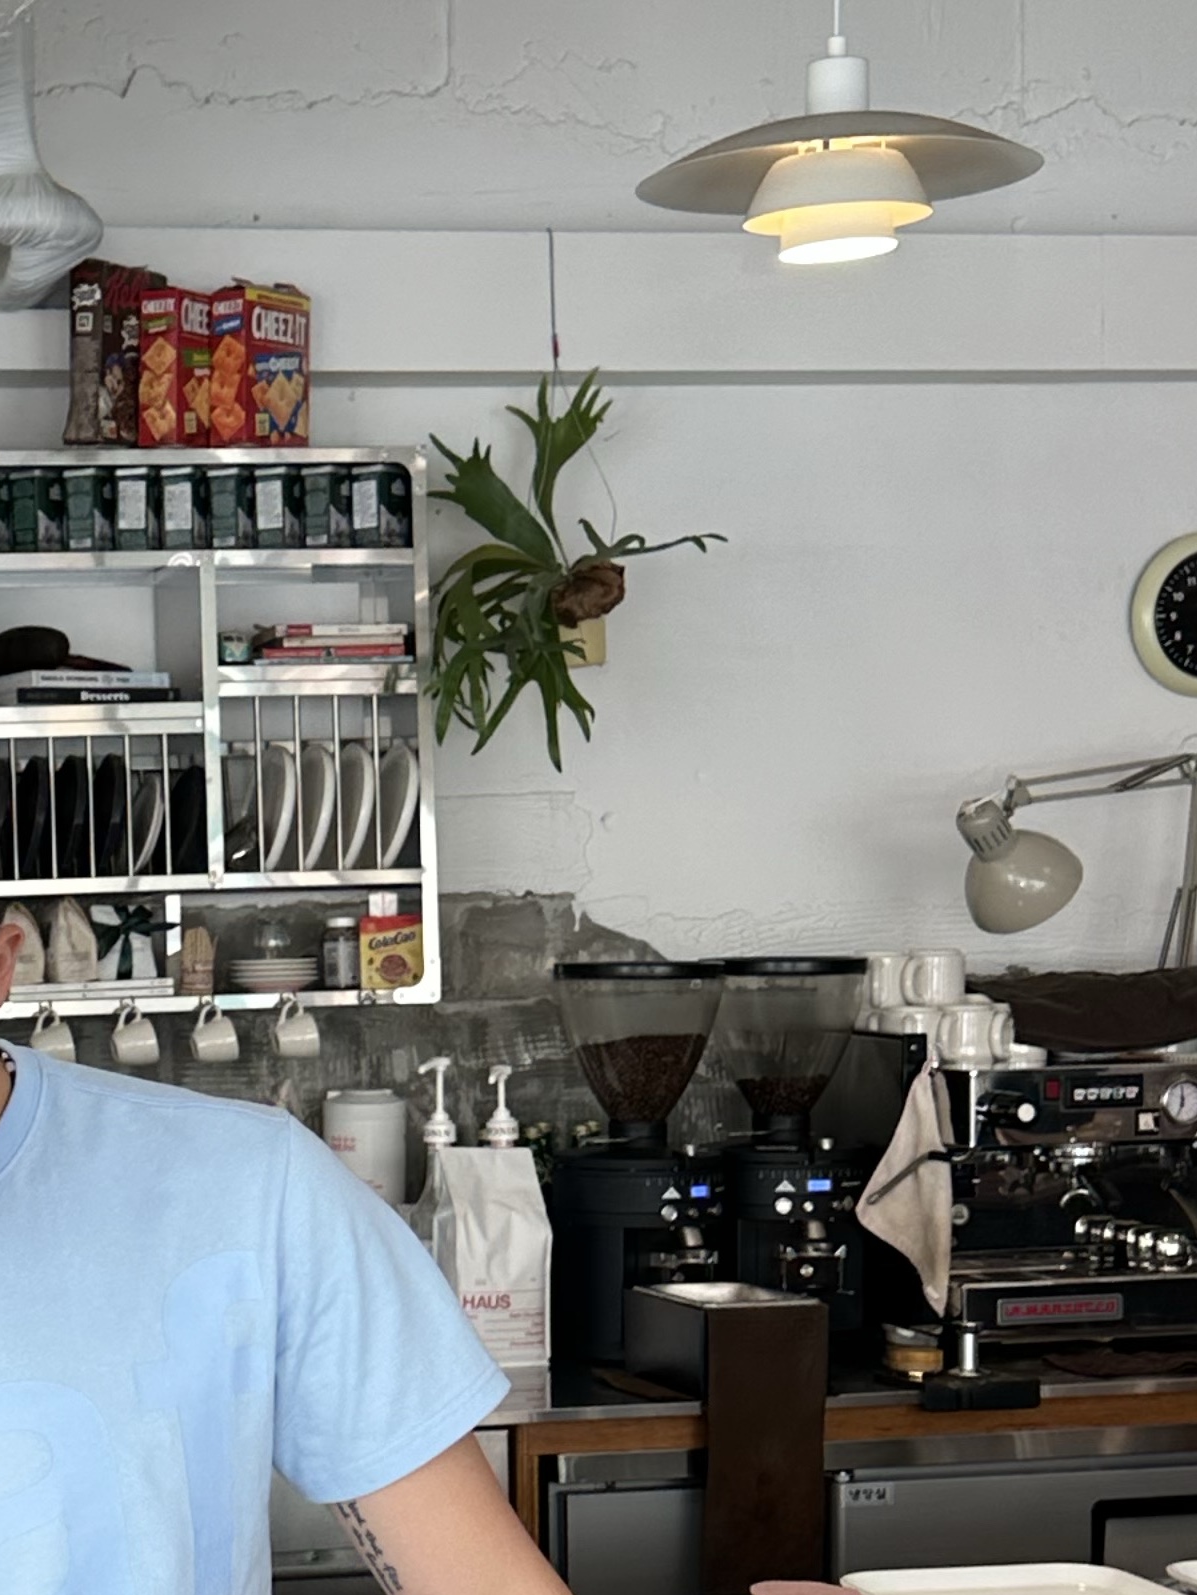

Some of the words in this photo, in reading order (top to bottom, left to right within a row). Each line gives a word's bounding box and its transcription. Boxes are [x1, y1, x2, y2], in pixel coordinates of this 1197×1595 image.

[181, 298, 210, 336] CHEE
[80, 690, 131, 702] Desserts
[461, 1293, 512, 1310] HAUS
